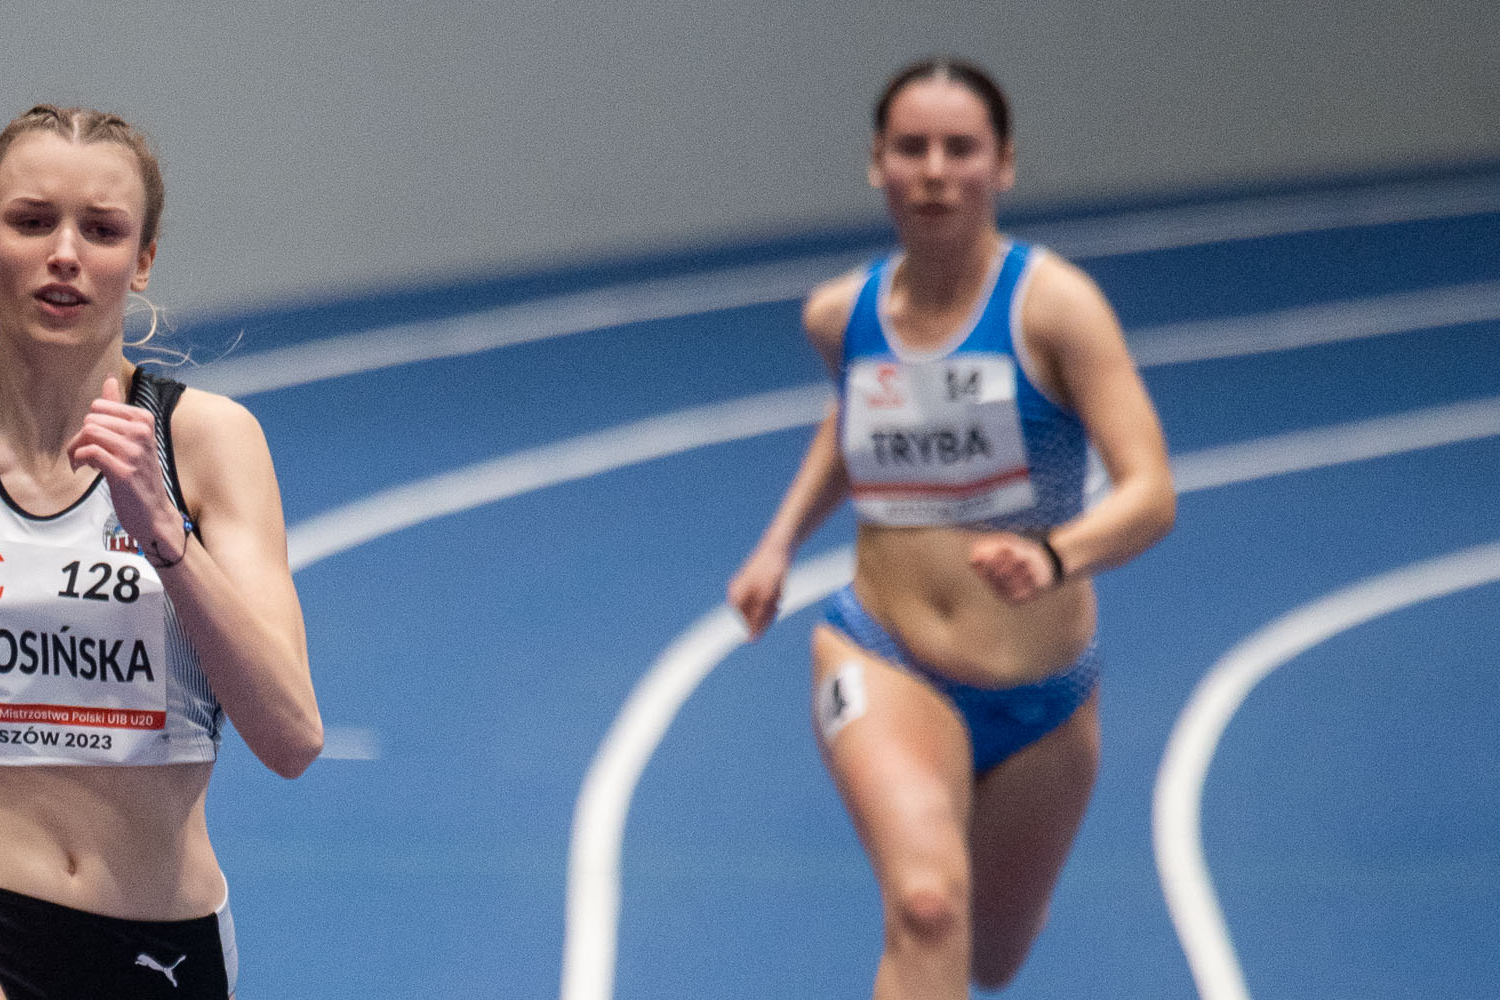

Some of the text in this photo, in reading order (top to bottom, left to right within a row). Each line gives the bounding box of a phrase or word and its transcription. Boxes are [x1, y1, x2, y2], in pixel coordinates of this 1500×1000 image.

[871, 427, 992, 466] TRYBA
[57, 560, 141, 604] 128
[0, 708, 69, 722] Mistrzostwa
[71, 710, 105, 724] Polski
[130, 714, 154, 726] U20
[65, 733, 113, 750] 2023
